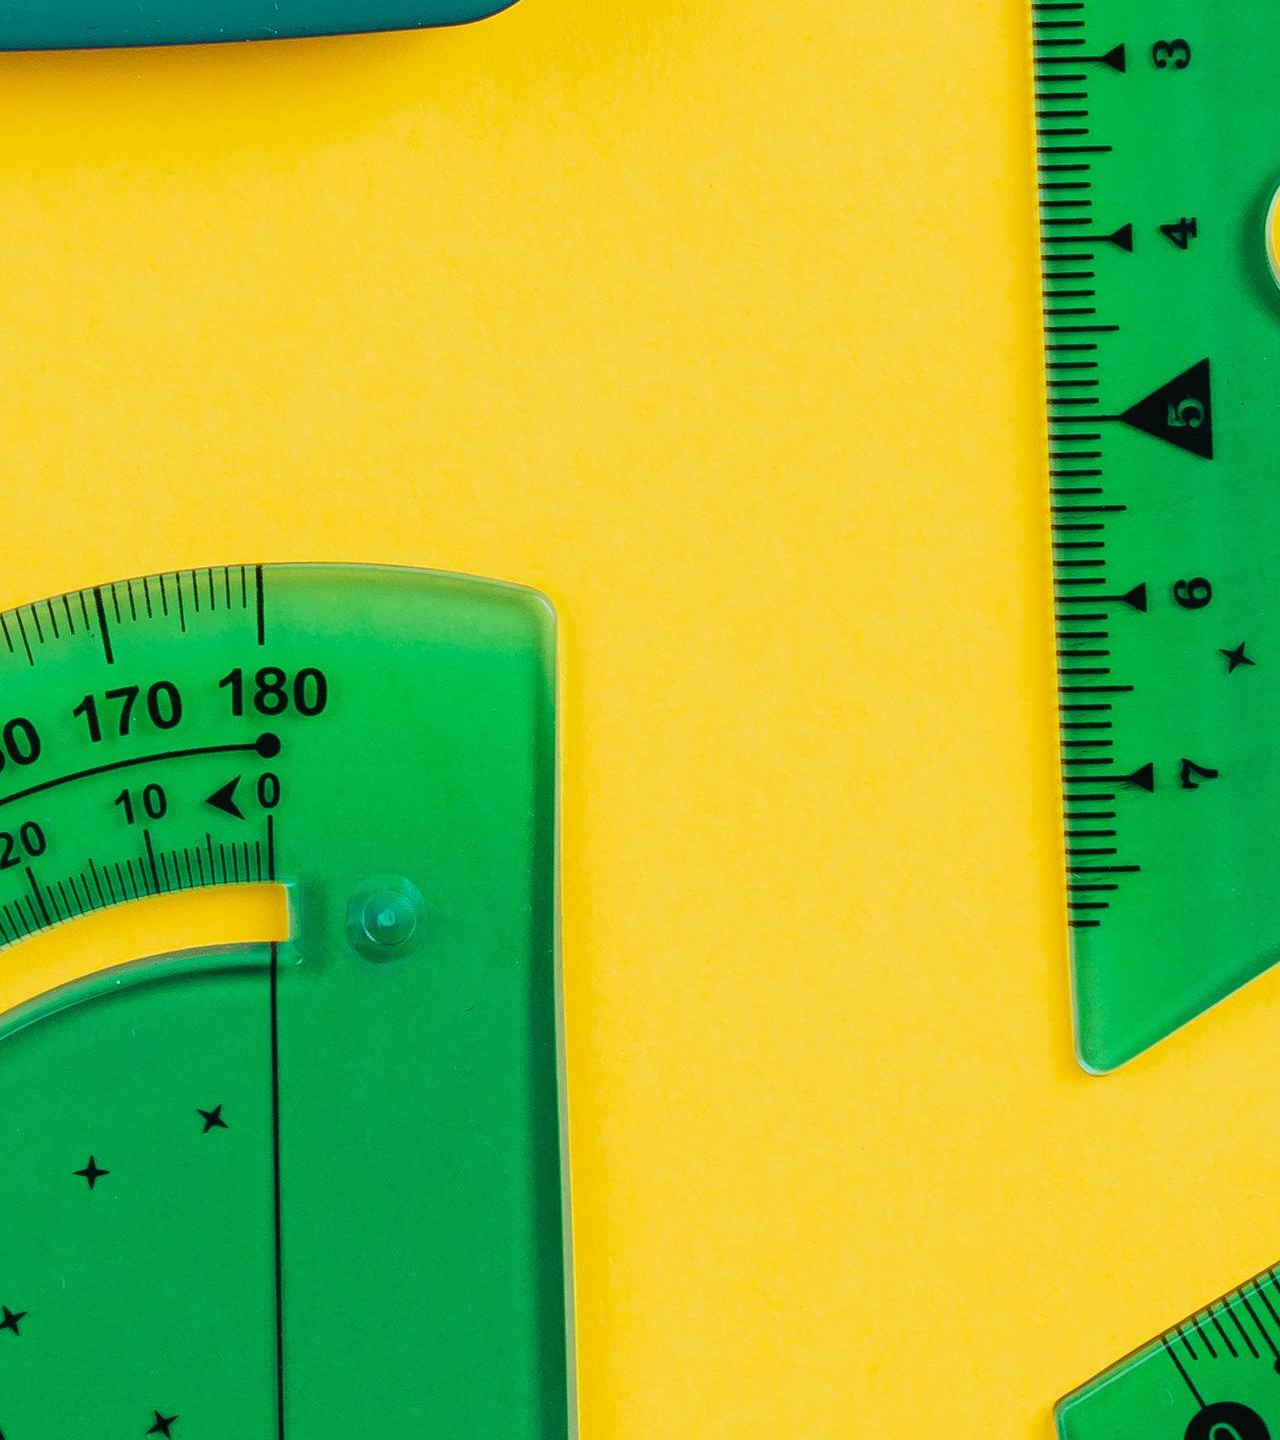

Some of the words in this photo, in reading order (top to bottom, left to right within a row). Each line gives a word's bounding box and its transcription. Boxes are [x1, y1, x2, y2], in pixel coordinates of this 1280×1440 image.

[1150, 37, 1193, 71] 3
[1158, 216, 1199, 252] 4
[1166, 397, 1205, 429] 5
[1171, 575, 1214, 611] 6
[71, 679, 184, 744] 170
[217, 665, 329, 718] 180
[1177, 756, 1220, 791] 7
[113, 782, 169, 826] 10
[256, 771, 282, 810] 0
